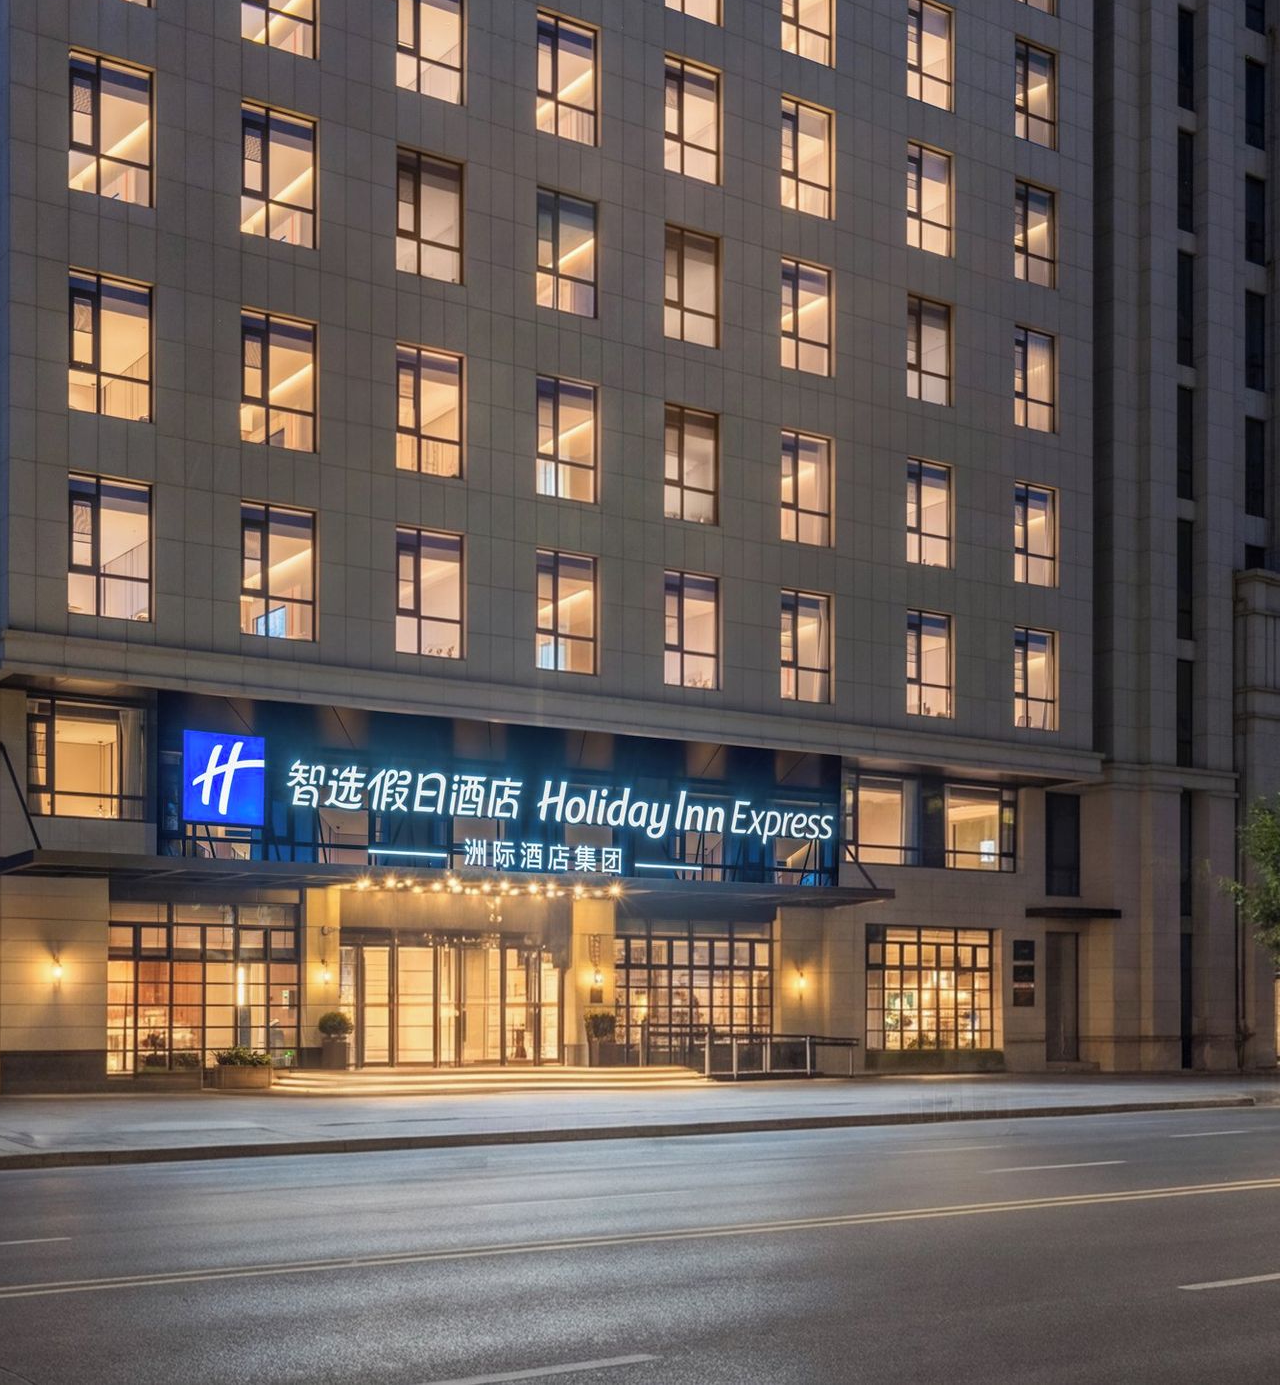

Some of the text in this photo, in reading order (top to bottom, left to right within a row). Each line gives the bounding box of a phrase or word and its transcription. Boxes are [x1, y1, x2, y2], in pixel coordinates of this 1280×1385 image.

[286, 759, 523, 821] 智选假日酒店
[538, 780, 834, 845] Holiday Inn Express
[463, 837, 624, 875] 洲际酒店集团
